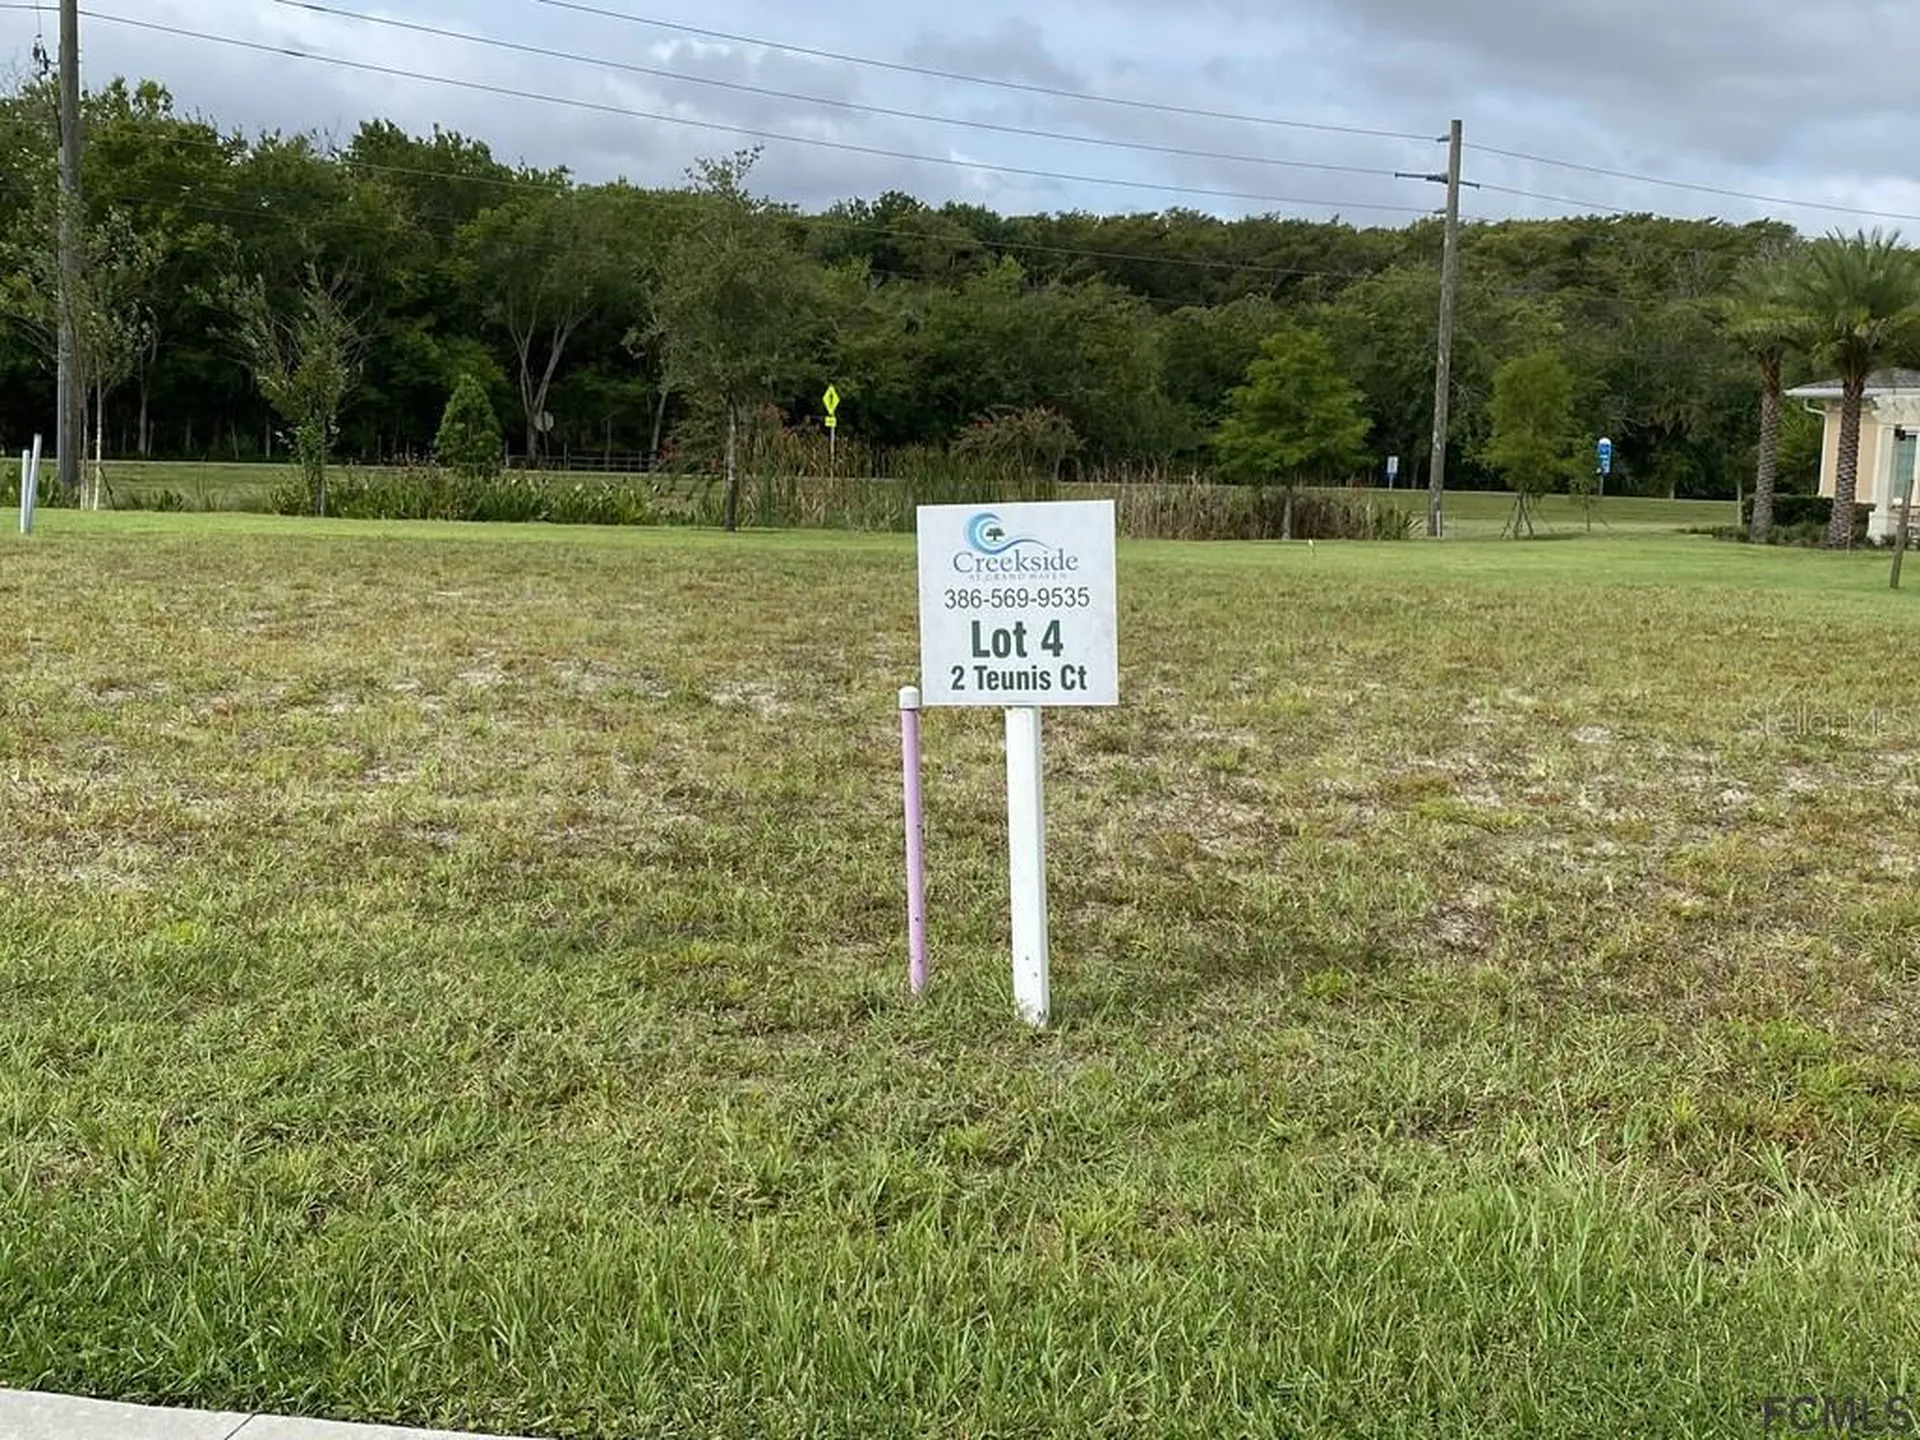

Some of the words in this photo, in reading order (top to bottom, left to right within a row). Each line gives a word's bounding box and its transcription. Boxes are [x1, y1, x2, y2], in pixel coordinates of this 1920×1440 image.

[953, 548, 1079, 573] Creekside
[944, 587, 1090, 610] 386-569-9535
[971, 620, 1027, 658] Lot
[1041, 619, 1064, 658] 4
[951, 665, 965, 690] 2
[974, 664, 1051, 690] Teunis
[1060, 664, 1088, 690] Ct
